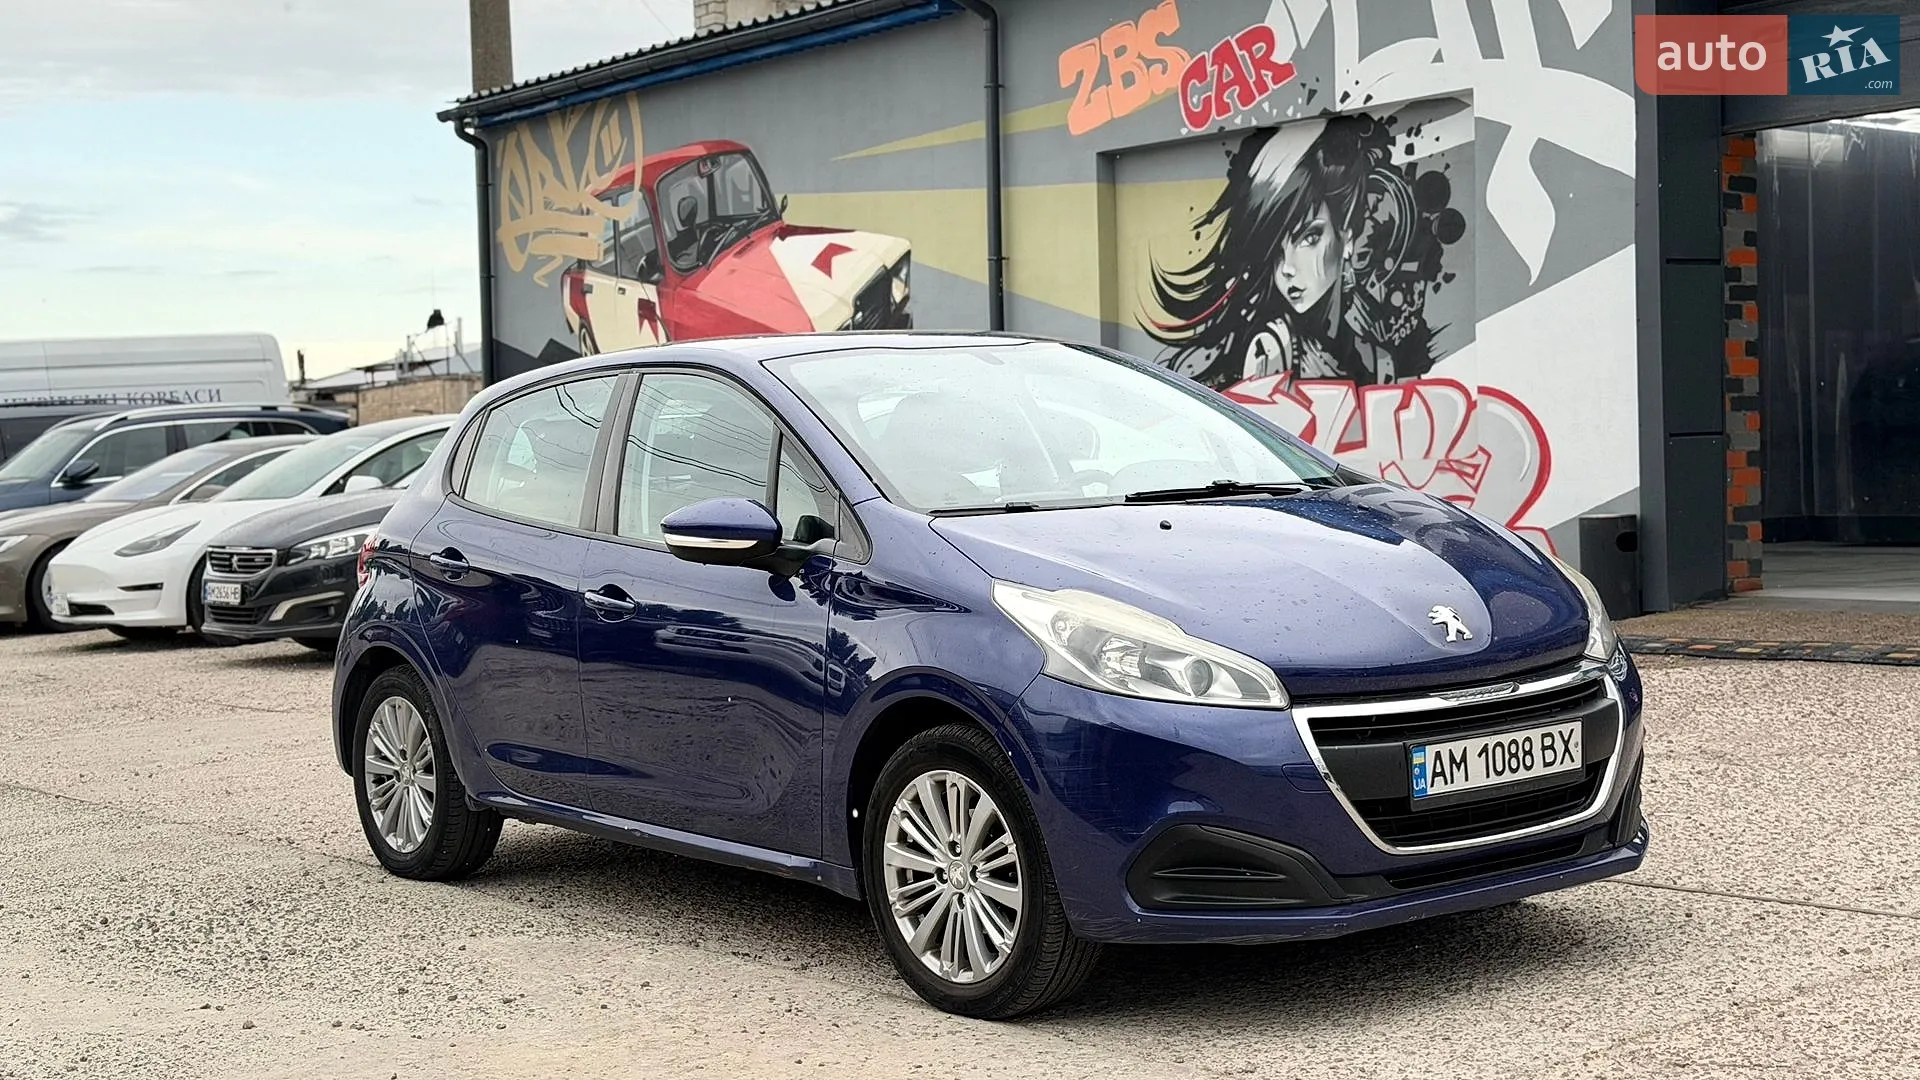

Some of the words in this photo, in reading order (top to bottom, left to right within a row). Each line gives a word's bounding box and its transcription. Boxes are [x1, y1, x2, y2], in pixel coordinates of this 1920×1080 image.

[1058, 0, 1192, 136] ZBS
[1178, 23, 1297, 132] CAR
[1413, 778, 1427, 791] UA
[1430, 746, 1469, 788] AM
[1477, 736, 1535, 779] 1088
[1541, 728, 1575, 768] BX
